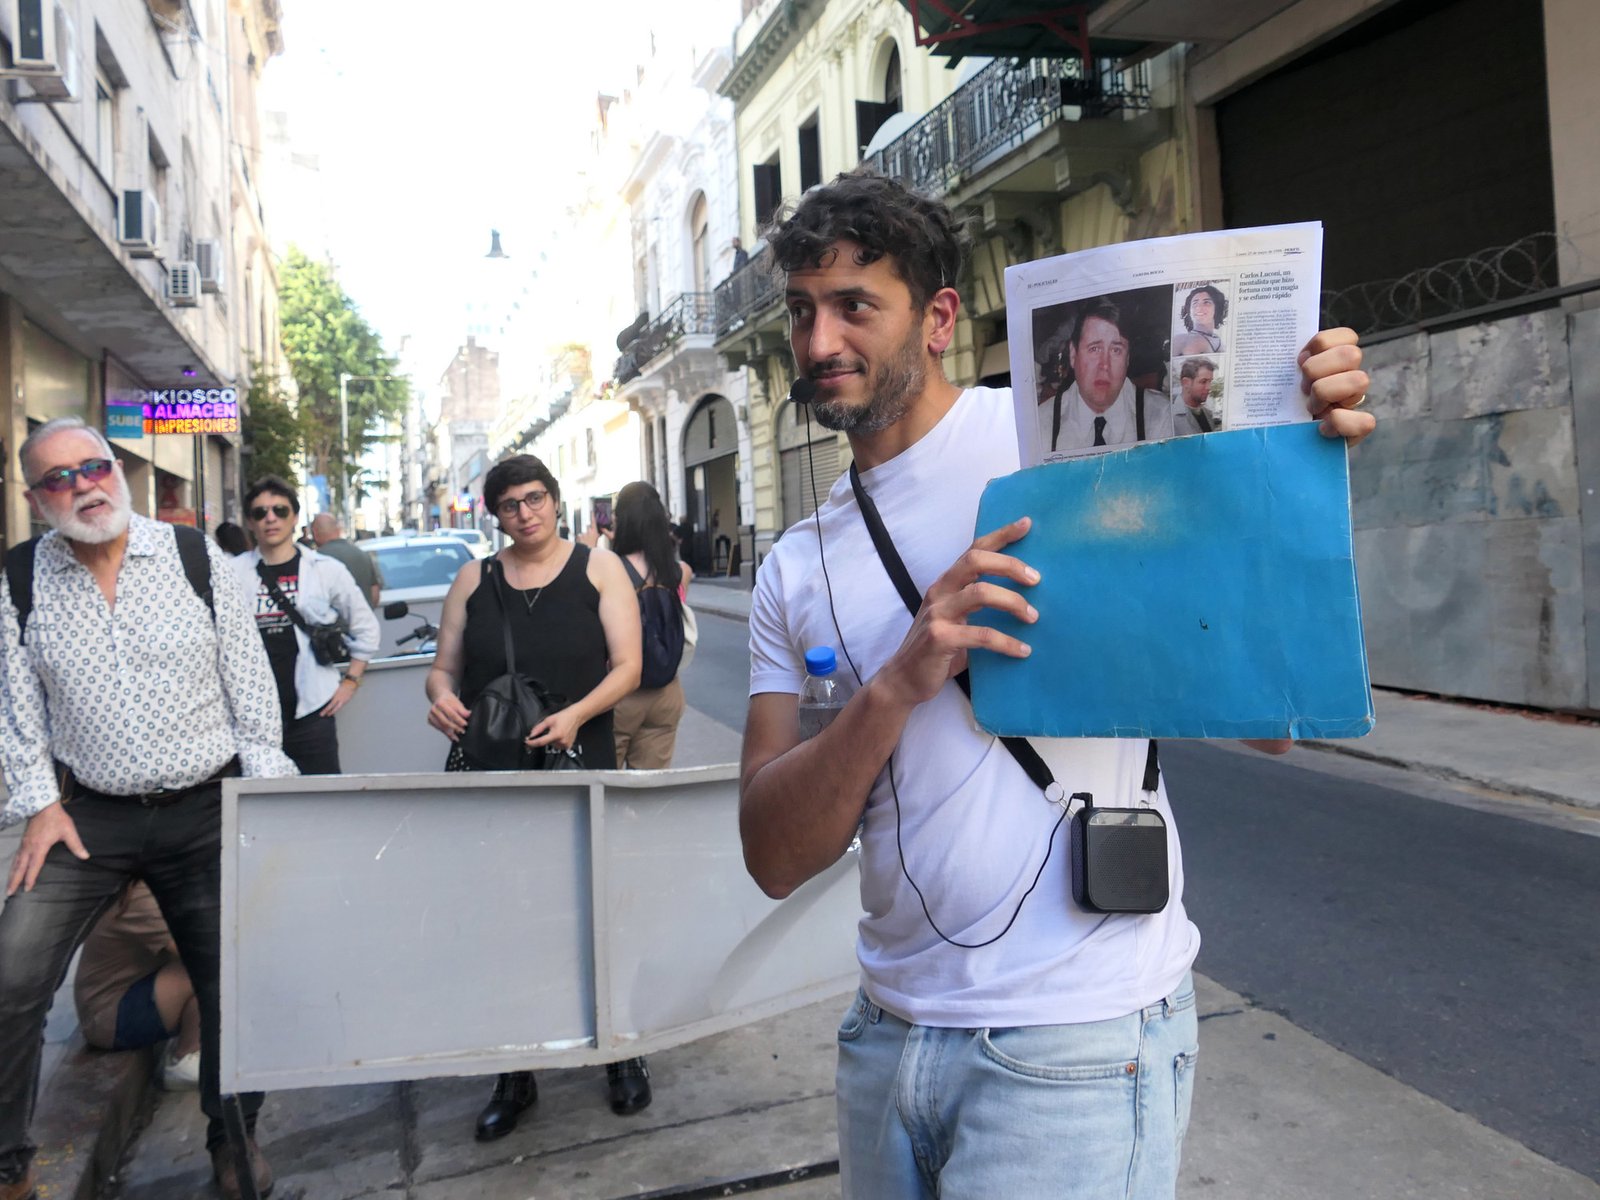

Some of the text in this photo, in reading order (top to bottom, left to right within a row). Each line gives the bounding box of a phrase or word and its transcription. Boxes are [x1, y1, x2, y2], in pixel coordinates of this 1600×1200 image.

[1240, 271, 1259, 279] Carlos
[1240, 279, 1269, 287] mentalista
[1272, 292, 1292, 300] rápido
[154, 403, 237, 418] ALMACEN
[108, 414, 141, 427] SUBE
[154, 418, 237, 434] IMPRESIONES
